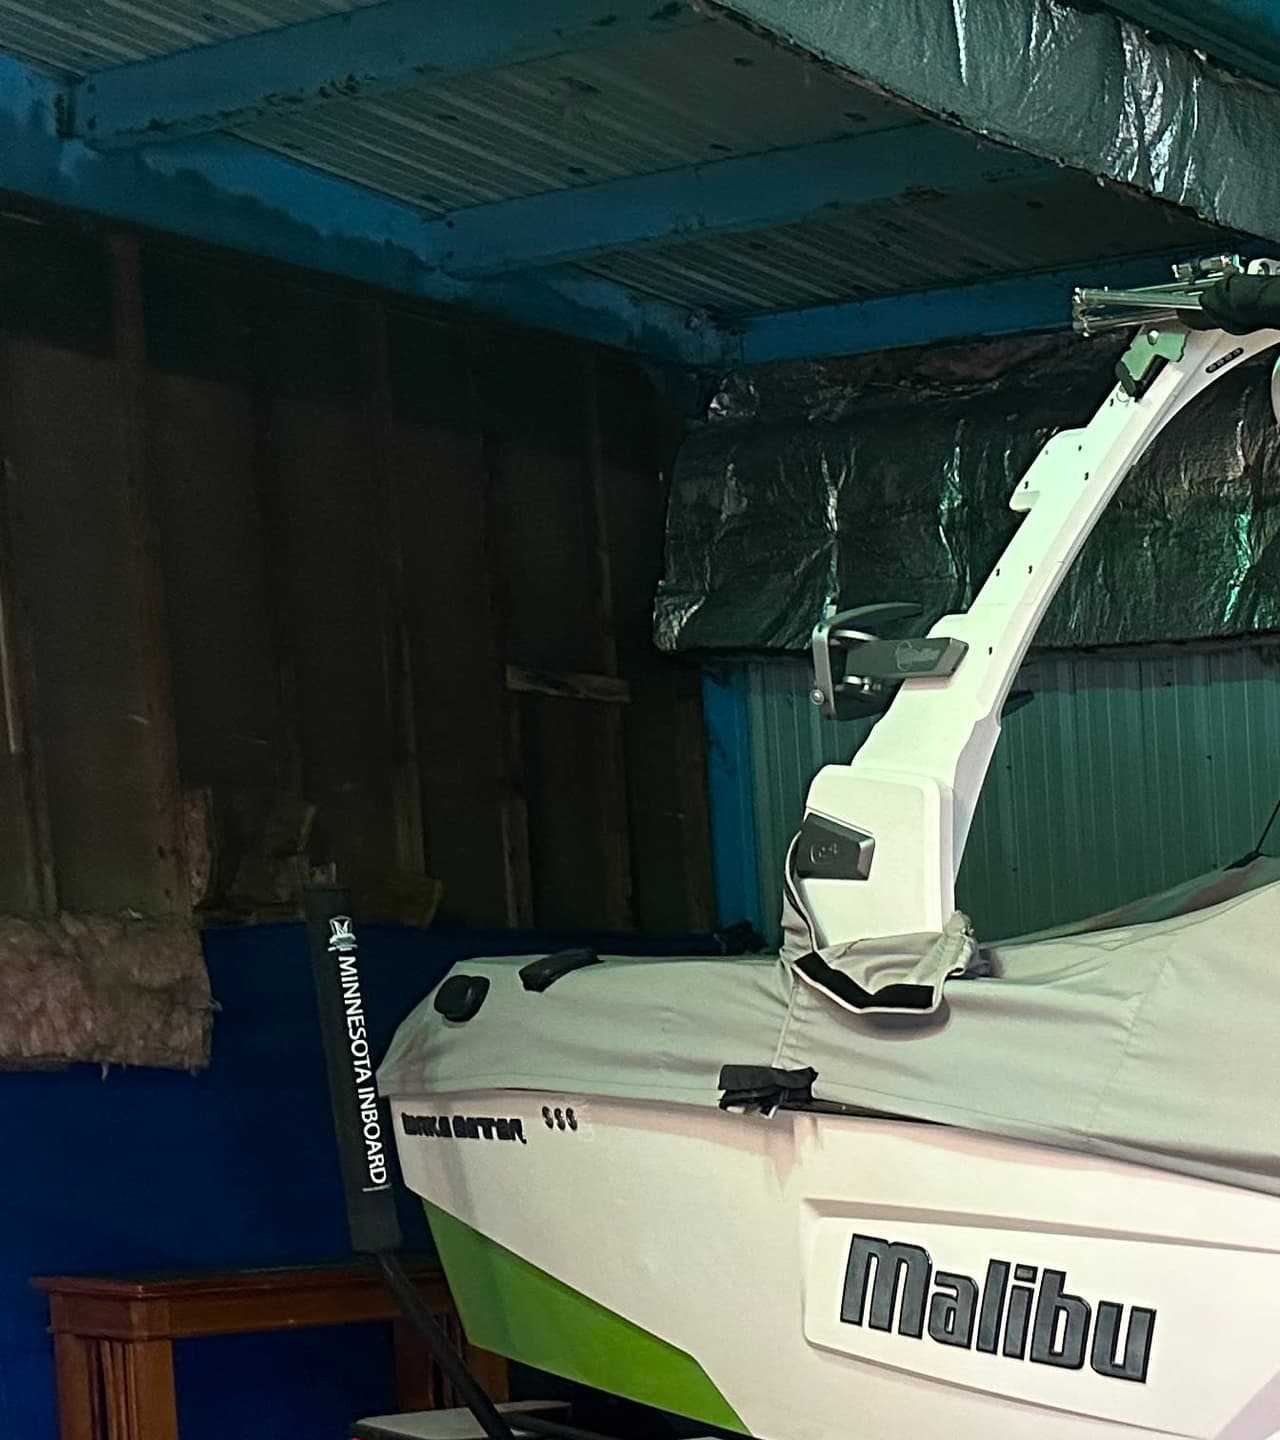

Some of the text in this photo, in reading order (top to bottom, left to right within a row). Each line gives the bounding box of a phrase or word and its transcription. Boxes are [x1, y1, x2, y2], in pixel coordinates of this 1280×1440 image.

[338, 955, 388, 1184] MINNESOTA INBOARD
[839, 1233, 1157, 1384] Malibu
